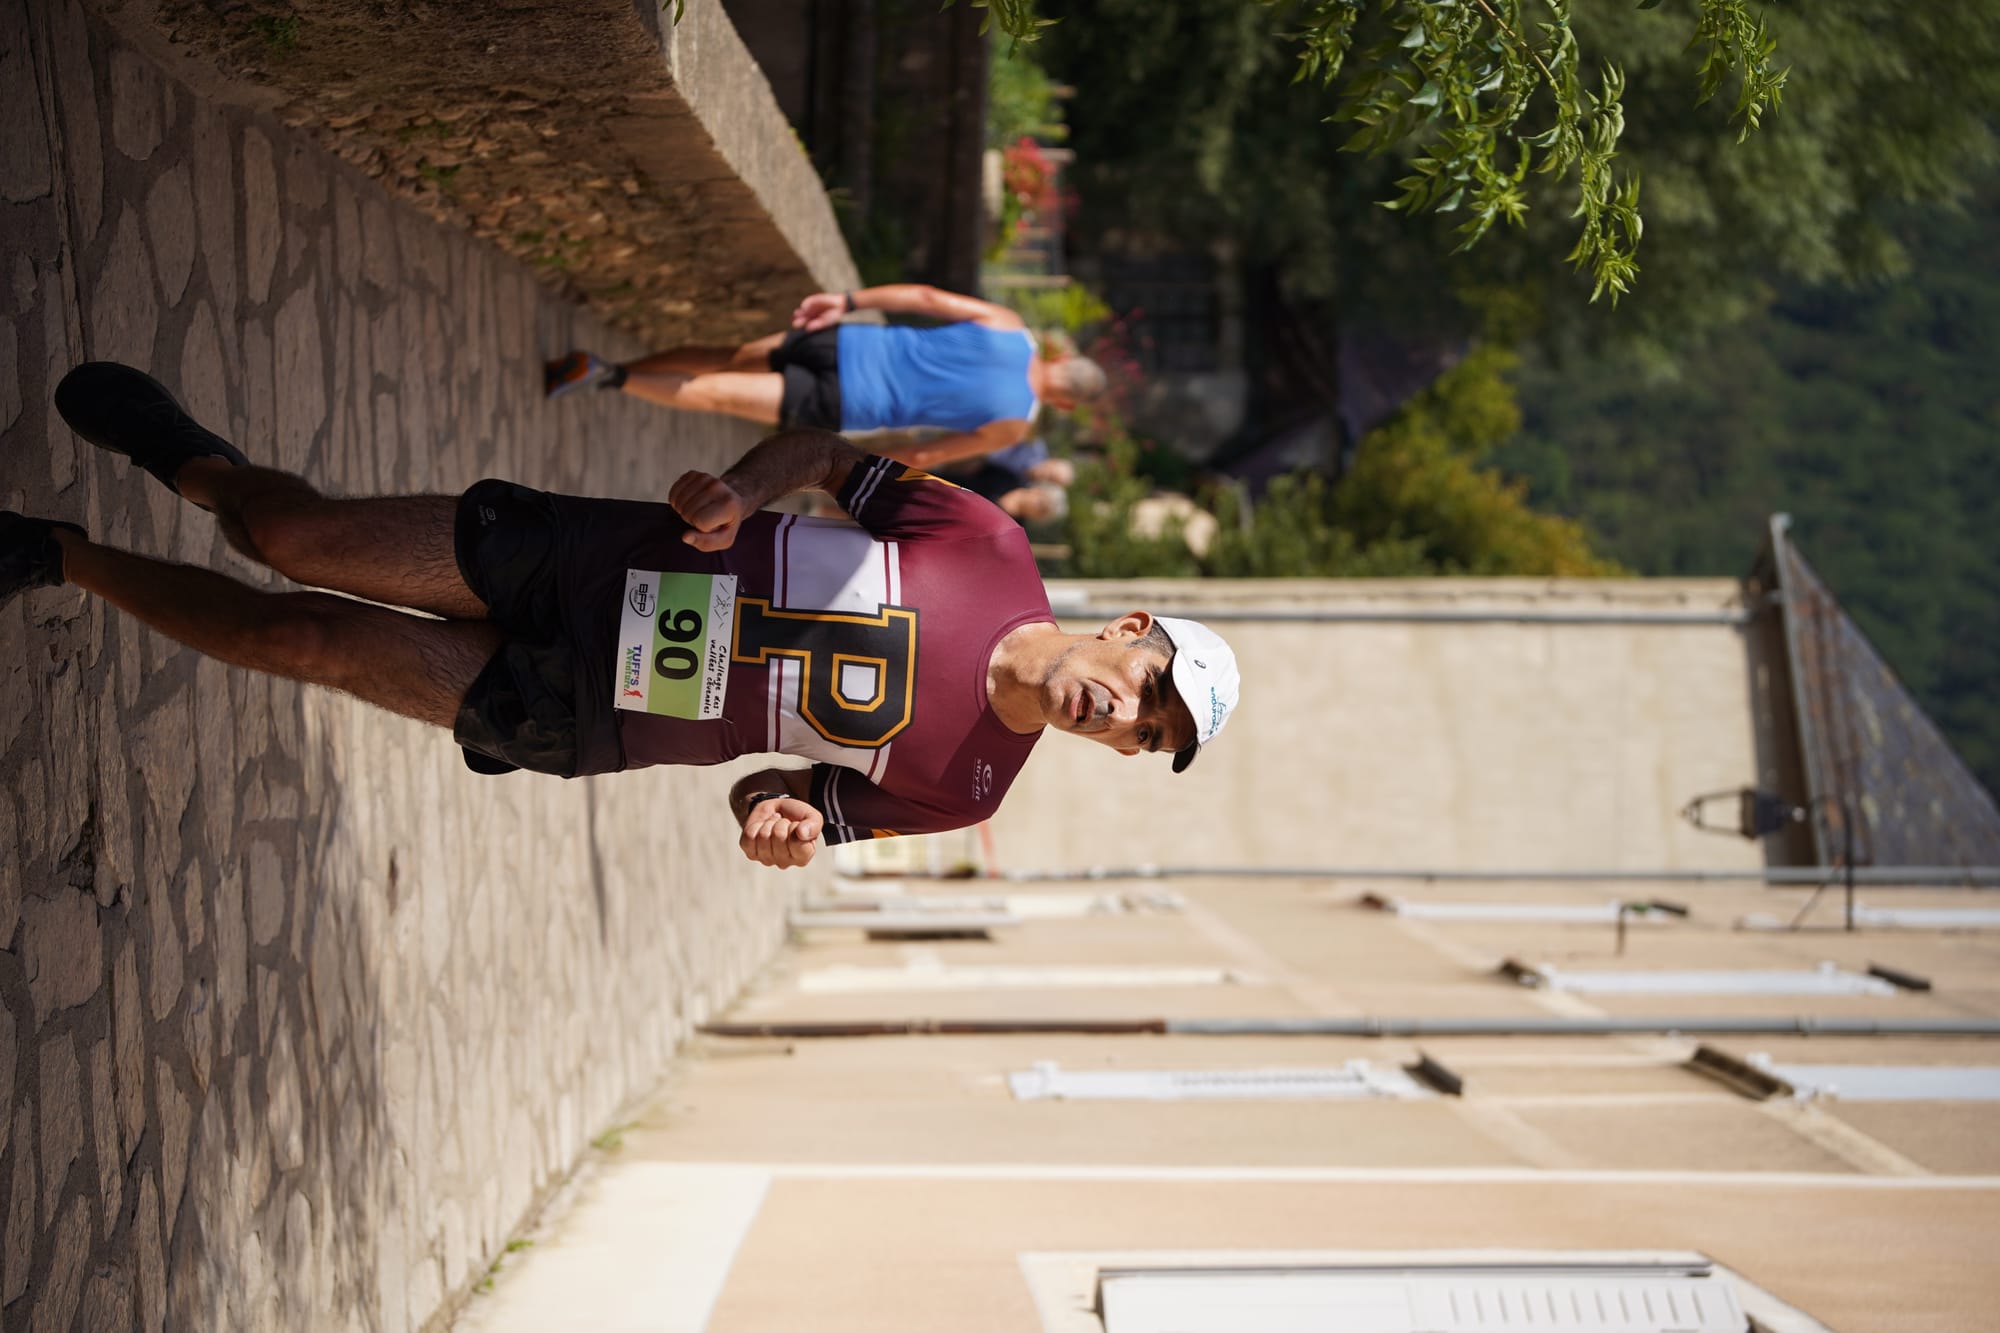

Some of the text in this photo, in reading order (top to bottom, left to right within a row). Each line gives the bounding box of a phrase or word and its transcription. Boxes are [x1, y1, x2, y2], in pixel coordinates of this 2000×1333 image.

[638, 583, 649, 612] BFP
[630, 644, 642, 686] TUFF'S
[654, 608, 702, 681] 90
[624, 648, 635, 689] Aventure
[713, 645, 727, 709] Challenge des
[732, 596, 920, 749] P
[974, 758, 982, 801] stry-fit
